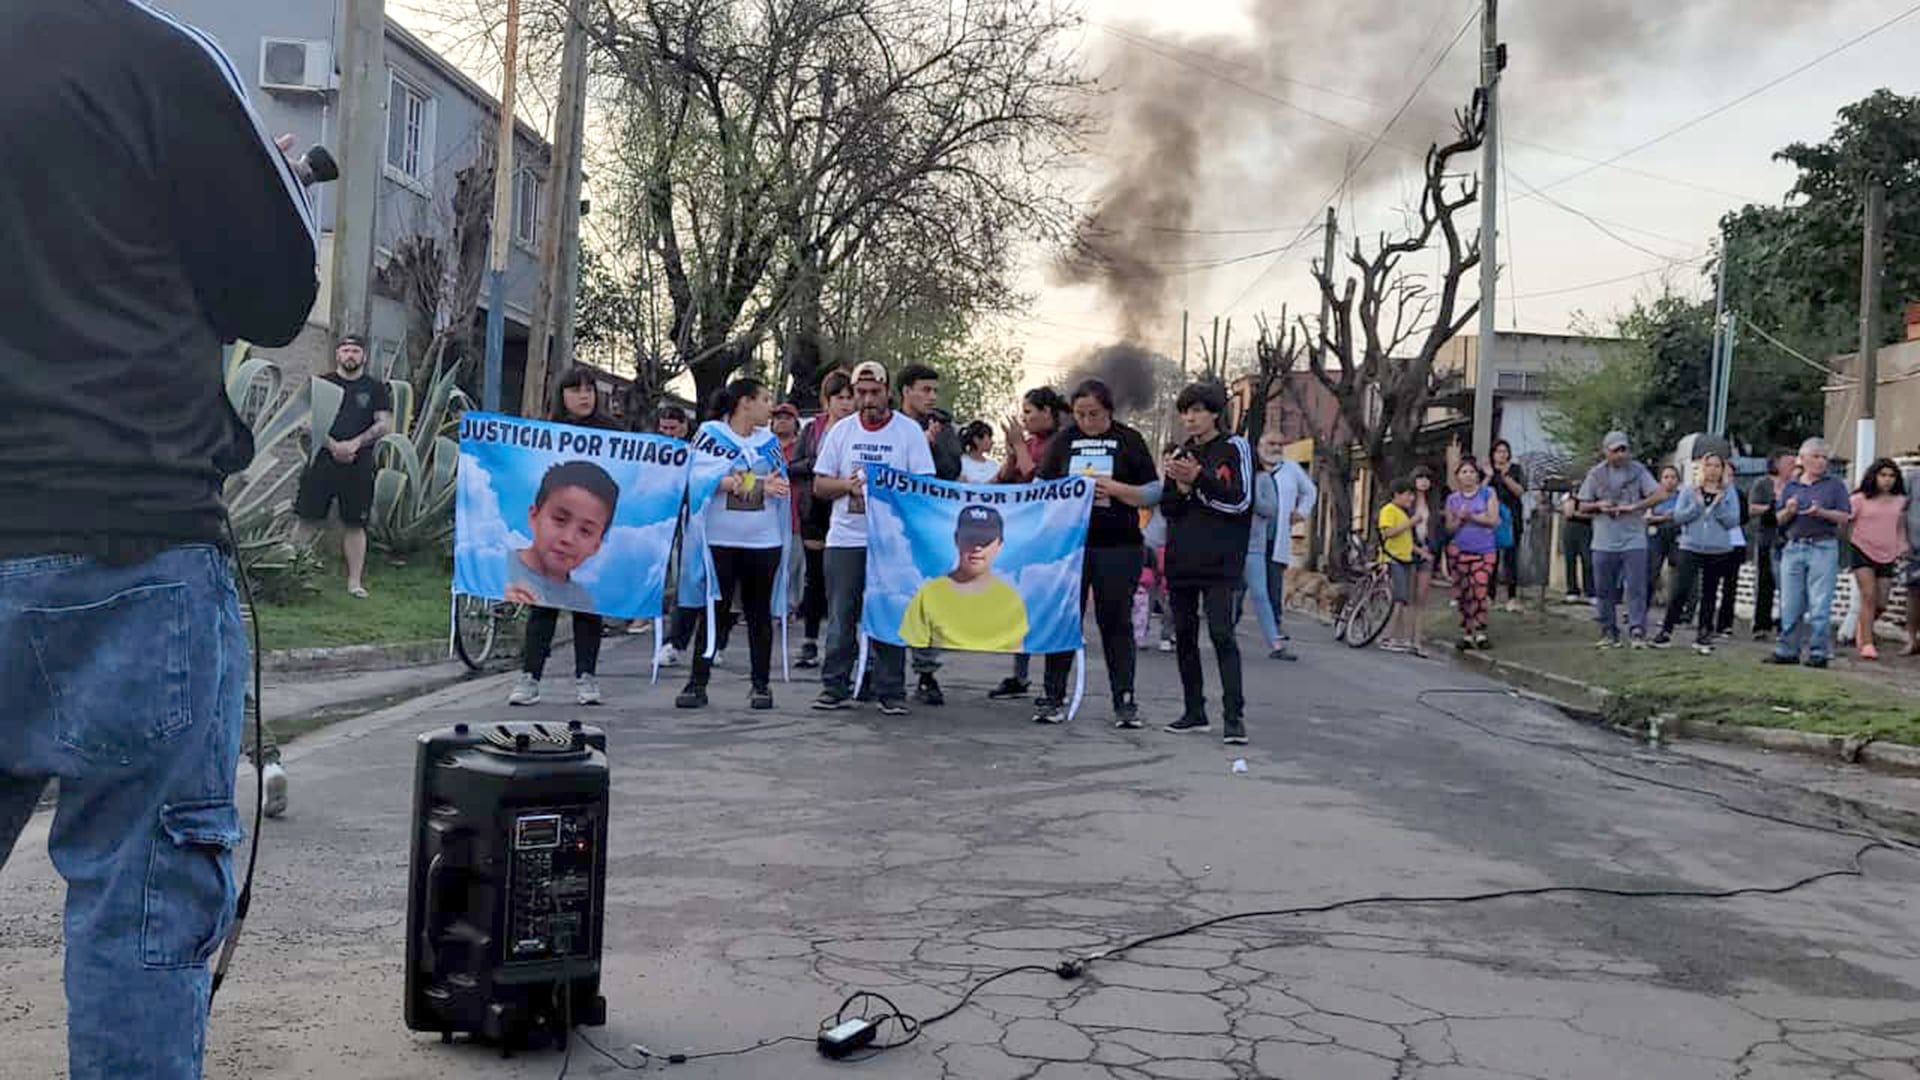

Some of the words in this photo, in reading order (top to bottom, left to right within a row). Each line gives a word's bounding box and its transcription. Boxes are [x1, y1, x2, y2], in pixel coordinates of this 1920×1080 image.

[461, 419, 553, 451] JUSTICIA
[558, 431, 603, 456] POR
[608, 436, 688, 466] THIAGO
[875, 467, 961, 501] JUSTICIA
[1014, 479, 1086, 503] THIAGO
